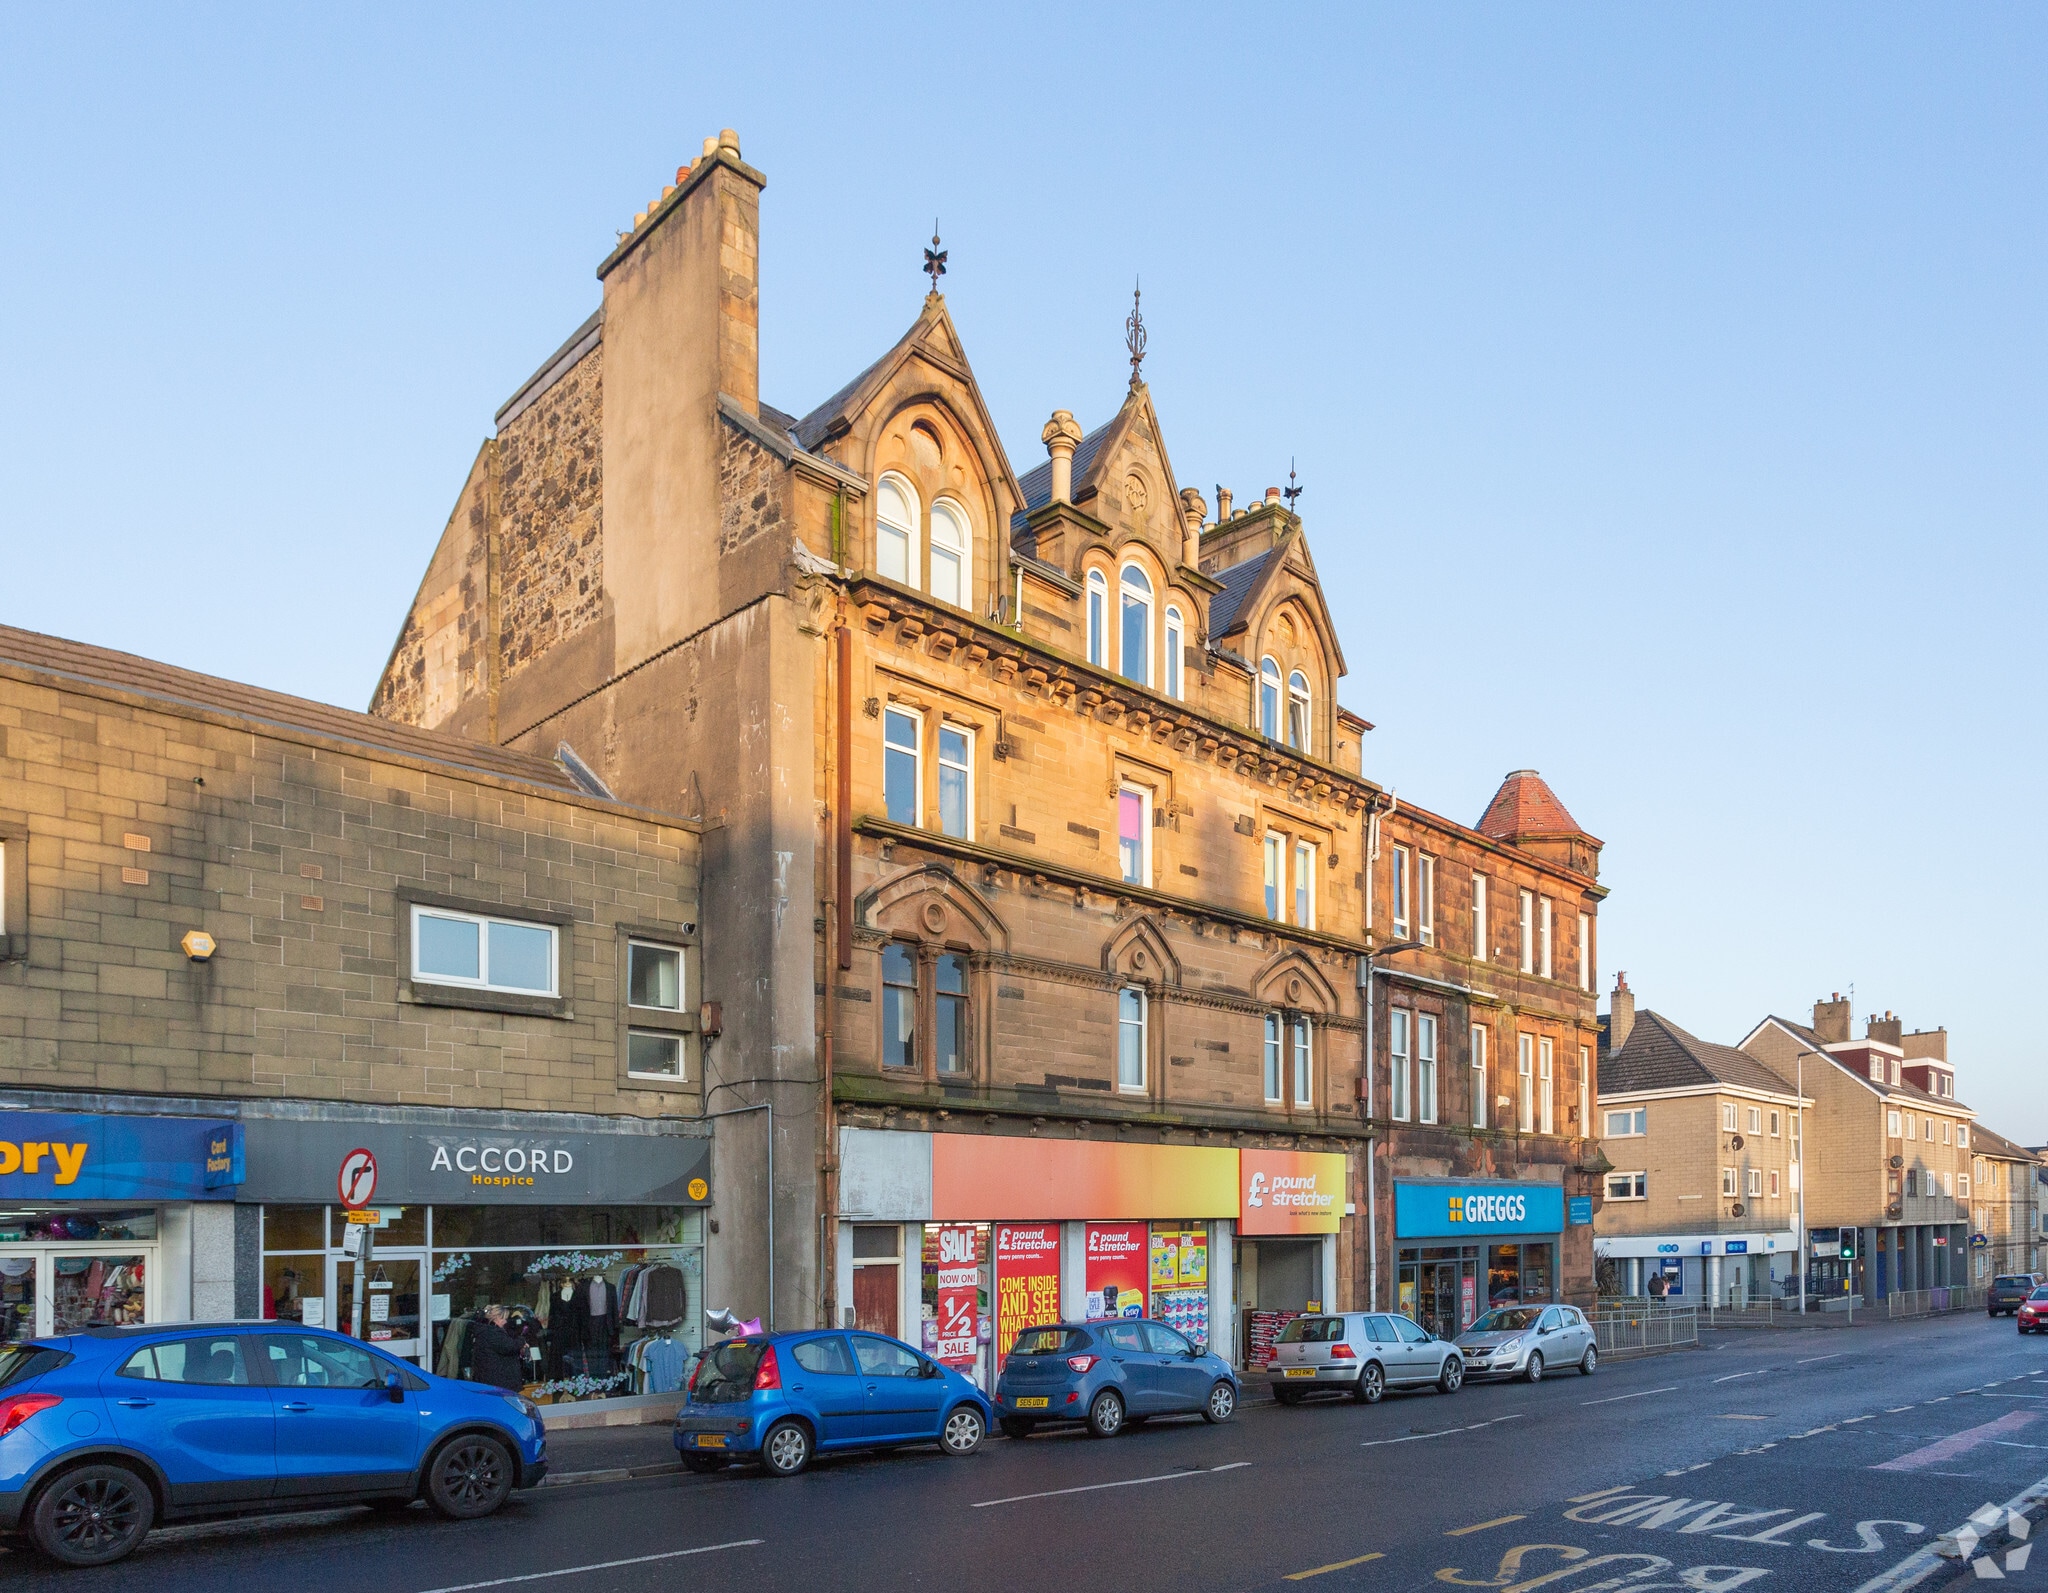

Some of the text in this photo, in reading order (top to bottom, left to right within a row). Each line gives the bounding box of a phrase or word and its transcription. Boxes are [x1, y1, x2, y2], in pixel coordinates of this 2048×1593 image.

[211, 1138, 227, 1155] Card
[207, 1157, 231, 1172] Factory
[430, 1146, 574, 1174] ACCORD
[472, 1174, 535, 1187] Hospice
[1272, 1174, 1317, 1192] pound
[1272, 1191, 1335, 1207] stretcher
[1465, 1195, 1526, 1223] GREGGS
[1012, 1229, 1045, 1243] pound
[1100, 1231, 1129, 1244] pound
[940, 1229, 975, 1263] SALE
[1011, 1239, 1057, 1250] stretcher
[1099, 1241, 1140, 1251] stretcher
[940, 1274, 976, 1284] NOW ON!
[1000, 1275, 1057, 1293] COME INSIDE
[1000, 1291, 1057, 1316] AND SEE
[1000, 1313, 1057, 1333] WHAT'S NEW
[944, 1342, 970, 1355] SALE
[1000, 1332, 1012, 1354] IN
[1019, 1398, 1032, 1406] SE15
[1564, 1495, 1926, 1554] STAND
